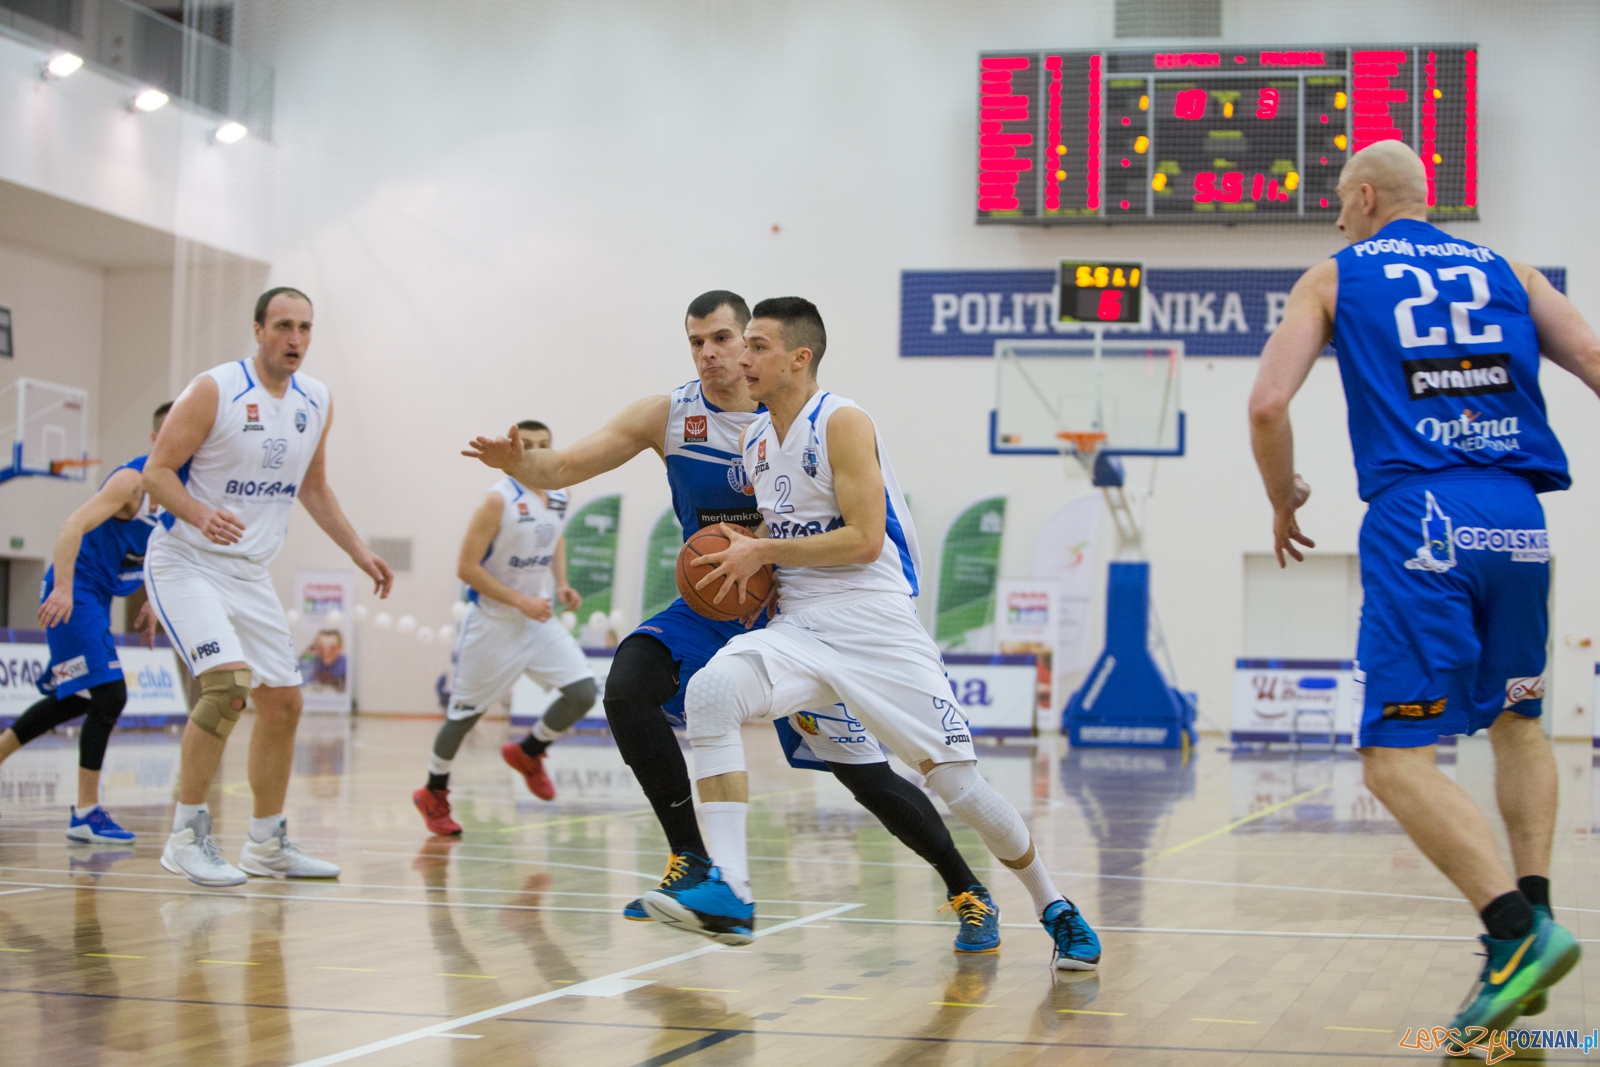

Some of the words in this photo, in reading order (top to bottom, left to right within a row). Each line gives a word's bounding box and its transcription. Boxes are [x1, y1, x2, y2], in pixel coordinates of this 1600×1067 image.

[1353, 238, 1416, 257] POGOŃ
[931, 292, 1249, 334] POLITNIKA
[1383, 262, 1504, 348] 22
[262, 438, 287, 469] 12
[225, 479, 297, 498] BIOFARM
[774, 475, 795, 514] 2
[197, 641, 220, 659] PBG
